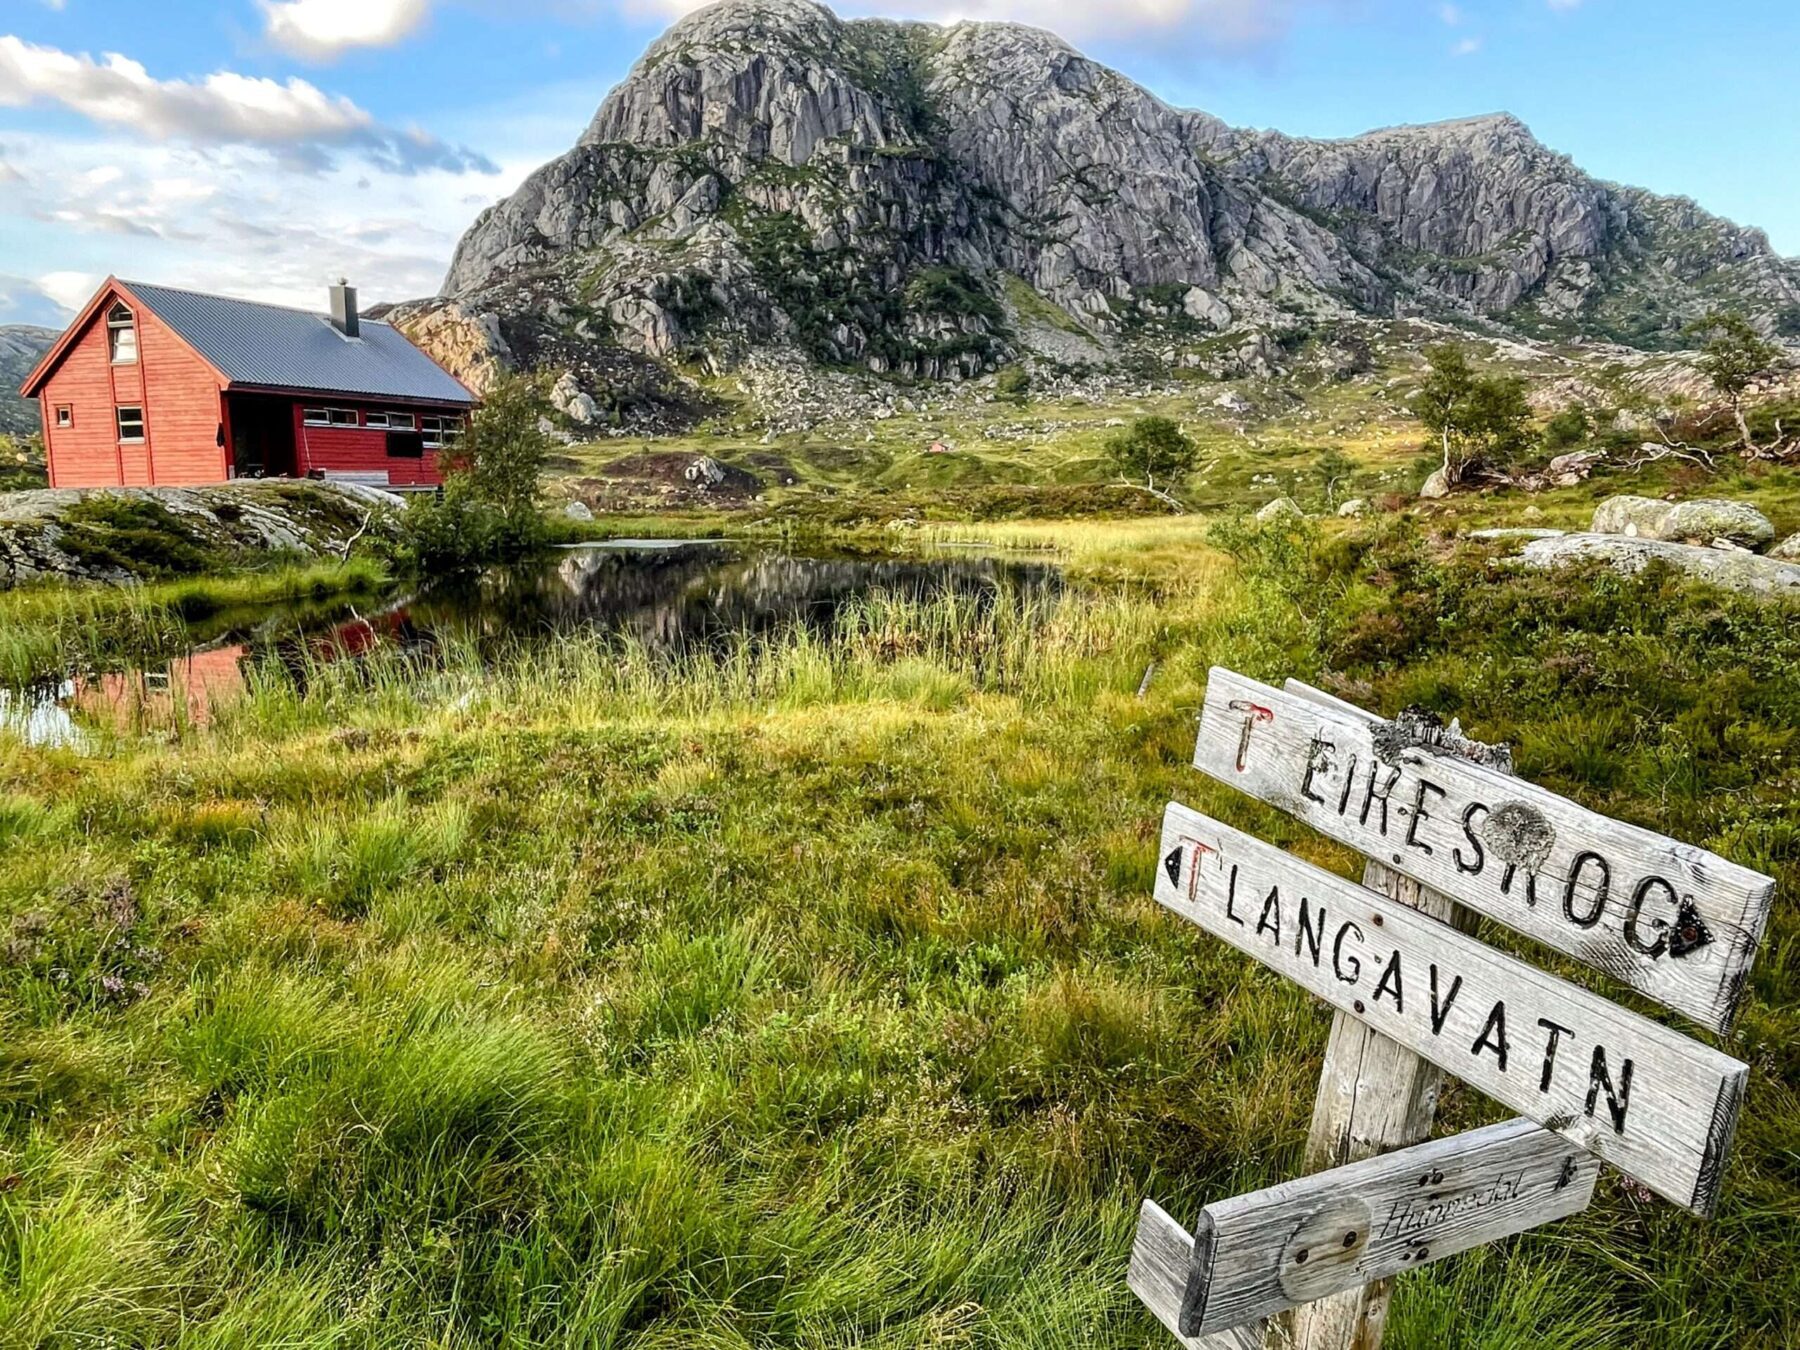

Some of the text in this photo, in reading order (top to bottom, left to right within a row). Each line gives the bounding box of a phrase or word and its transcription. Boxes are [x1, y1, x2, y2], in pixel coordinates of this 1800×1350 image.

[1228, 700, 1273, 772] T
[1178, 834, 1635, 1134] T LANGAVATN
